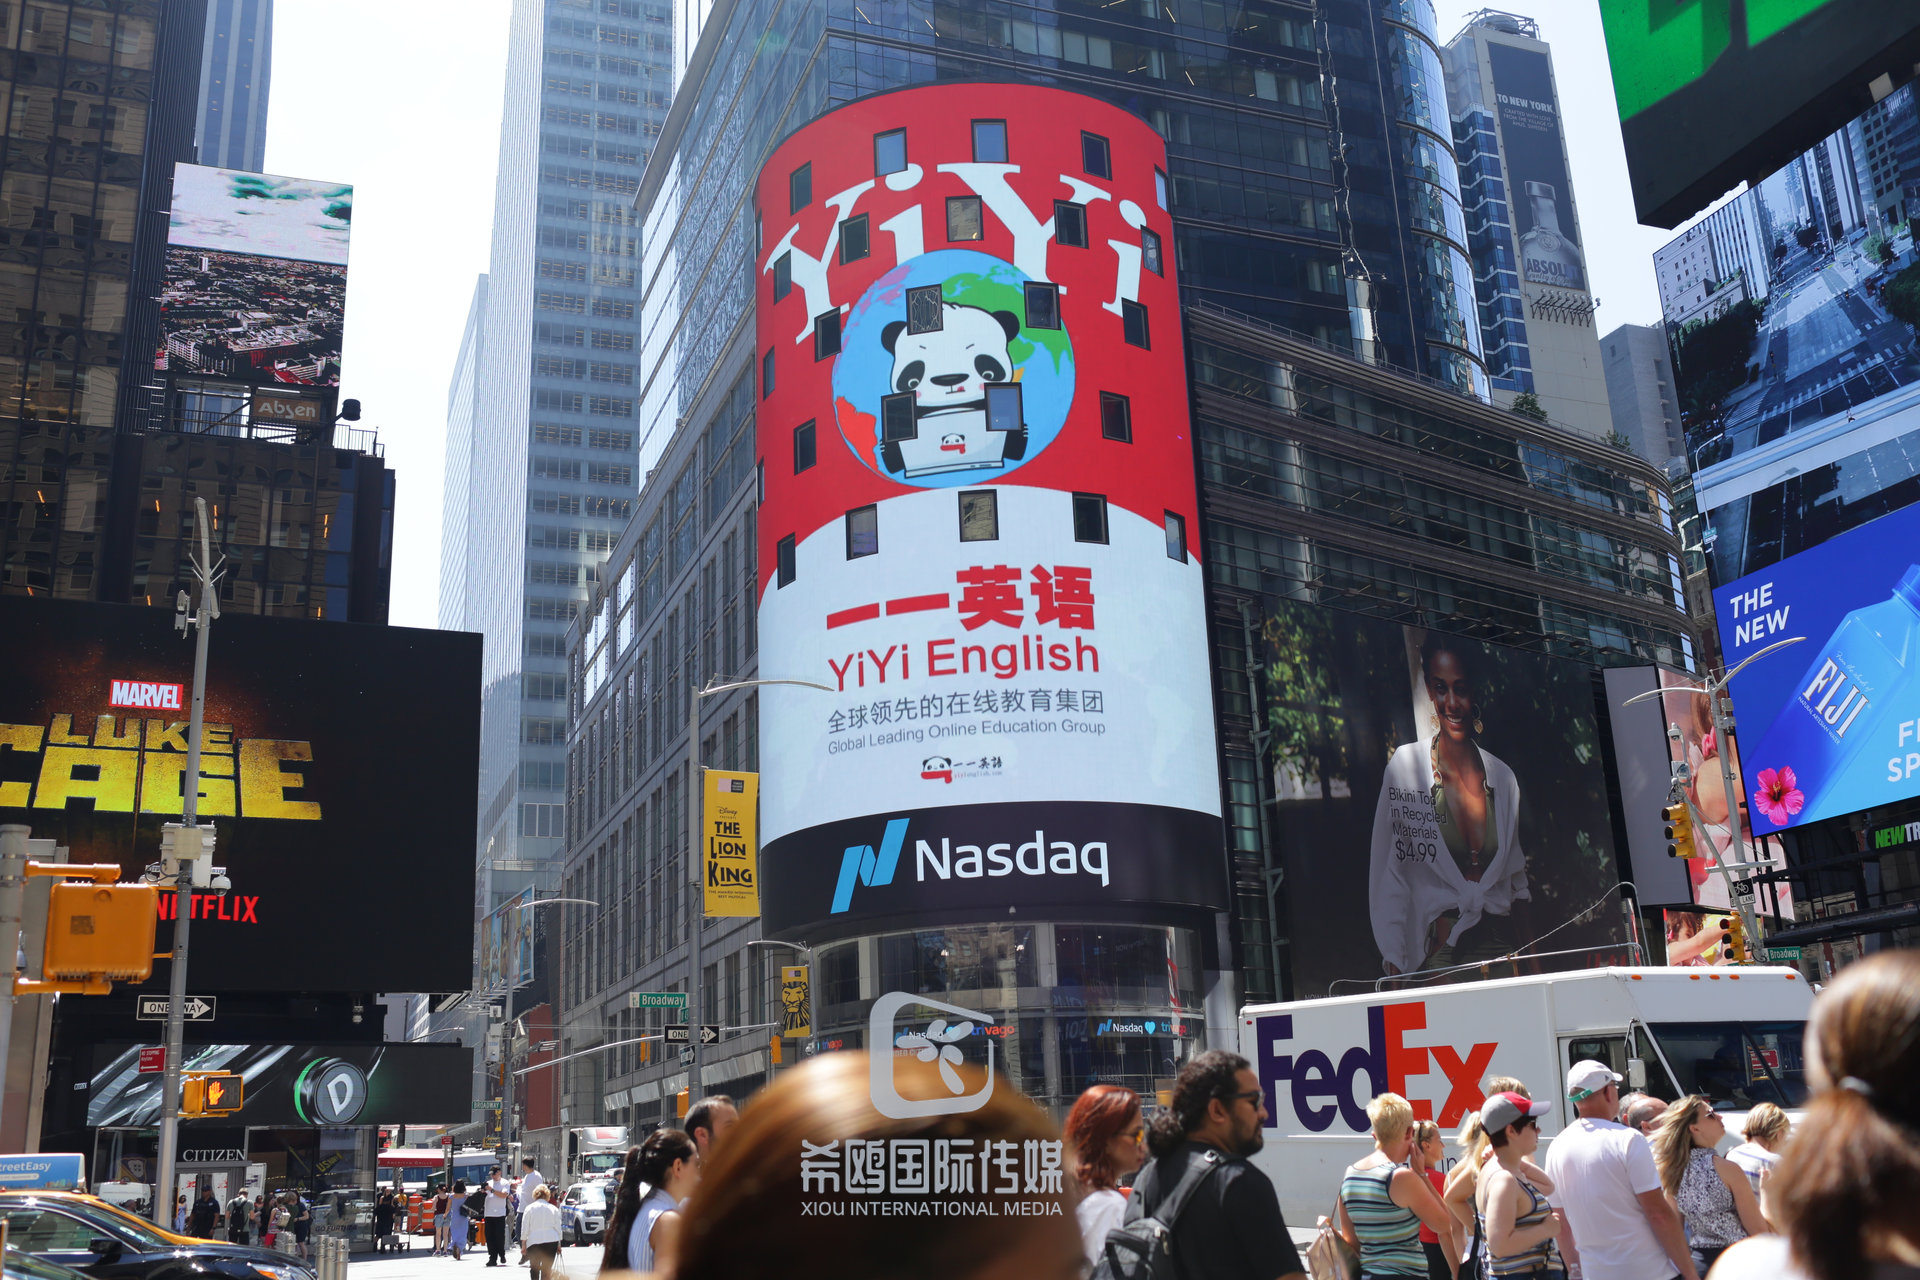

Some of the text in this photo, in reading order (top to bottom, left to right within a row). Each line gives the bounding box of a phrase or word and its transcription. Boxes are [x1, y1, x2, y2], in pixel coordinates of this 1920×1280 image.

[1497, 93, 1508, 103] TO
[1509, 96, 1528, 108] NEW
[763, 162, 1147, 344] YiYi
[258, 401, 316, 419] Absen
[826, 564, 1095, 631] 一一英语
[1730, 582, 1773, 619] THE
[1736, 605, 1790, 647] NEW
[828, 634, 1099, 692] YiYi English
[111, 681, 181, 710] MARVEL
[1802, 657, 1870, 738] FIJI
[828, 688, 1104, 735] 全球领先的在线教育集团
[48, 713, 234, 753] LUKE
[828, 718, 1106, 755] Global Leading Online Education Group
[1389, 787, 1437, 808] Bikini Top
[1390, 804, 1447, 825] in Recycled
[714, 821, 740, 834] THE
[1392, 822, 1438, 840] Materials
[915, 830, 1110, 887] Nasdaq
[1395, 838, 1437, 863] $4.99
[1742, 895, 1755, 903] LANE
[1770, 948, 1800, 960] Broadway
[150, 1003, 169, 1013] ONE
[642, 994, 685, 1007] Broadway
[971, 1023, 1015, 1038] trivago
[1112, 1023, 1144, 1034] Nasdaq
[1256, 1001, 1499, 1133] FedEx
[473, 1101, 500, 1109] BROADWAY
[183, 1149, 245, 1162] CITIZEN
